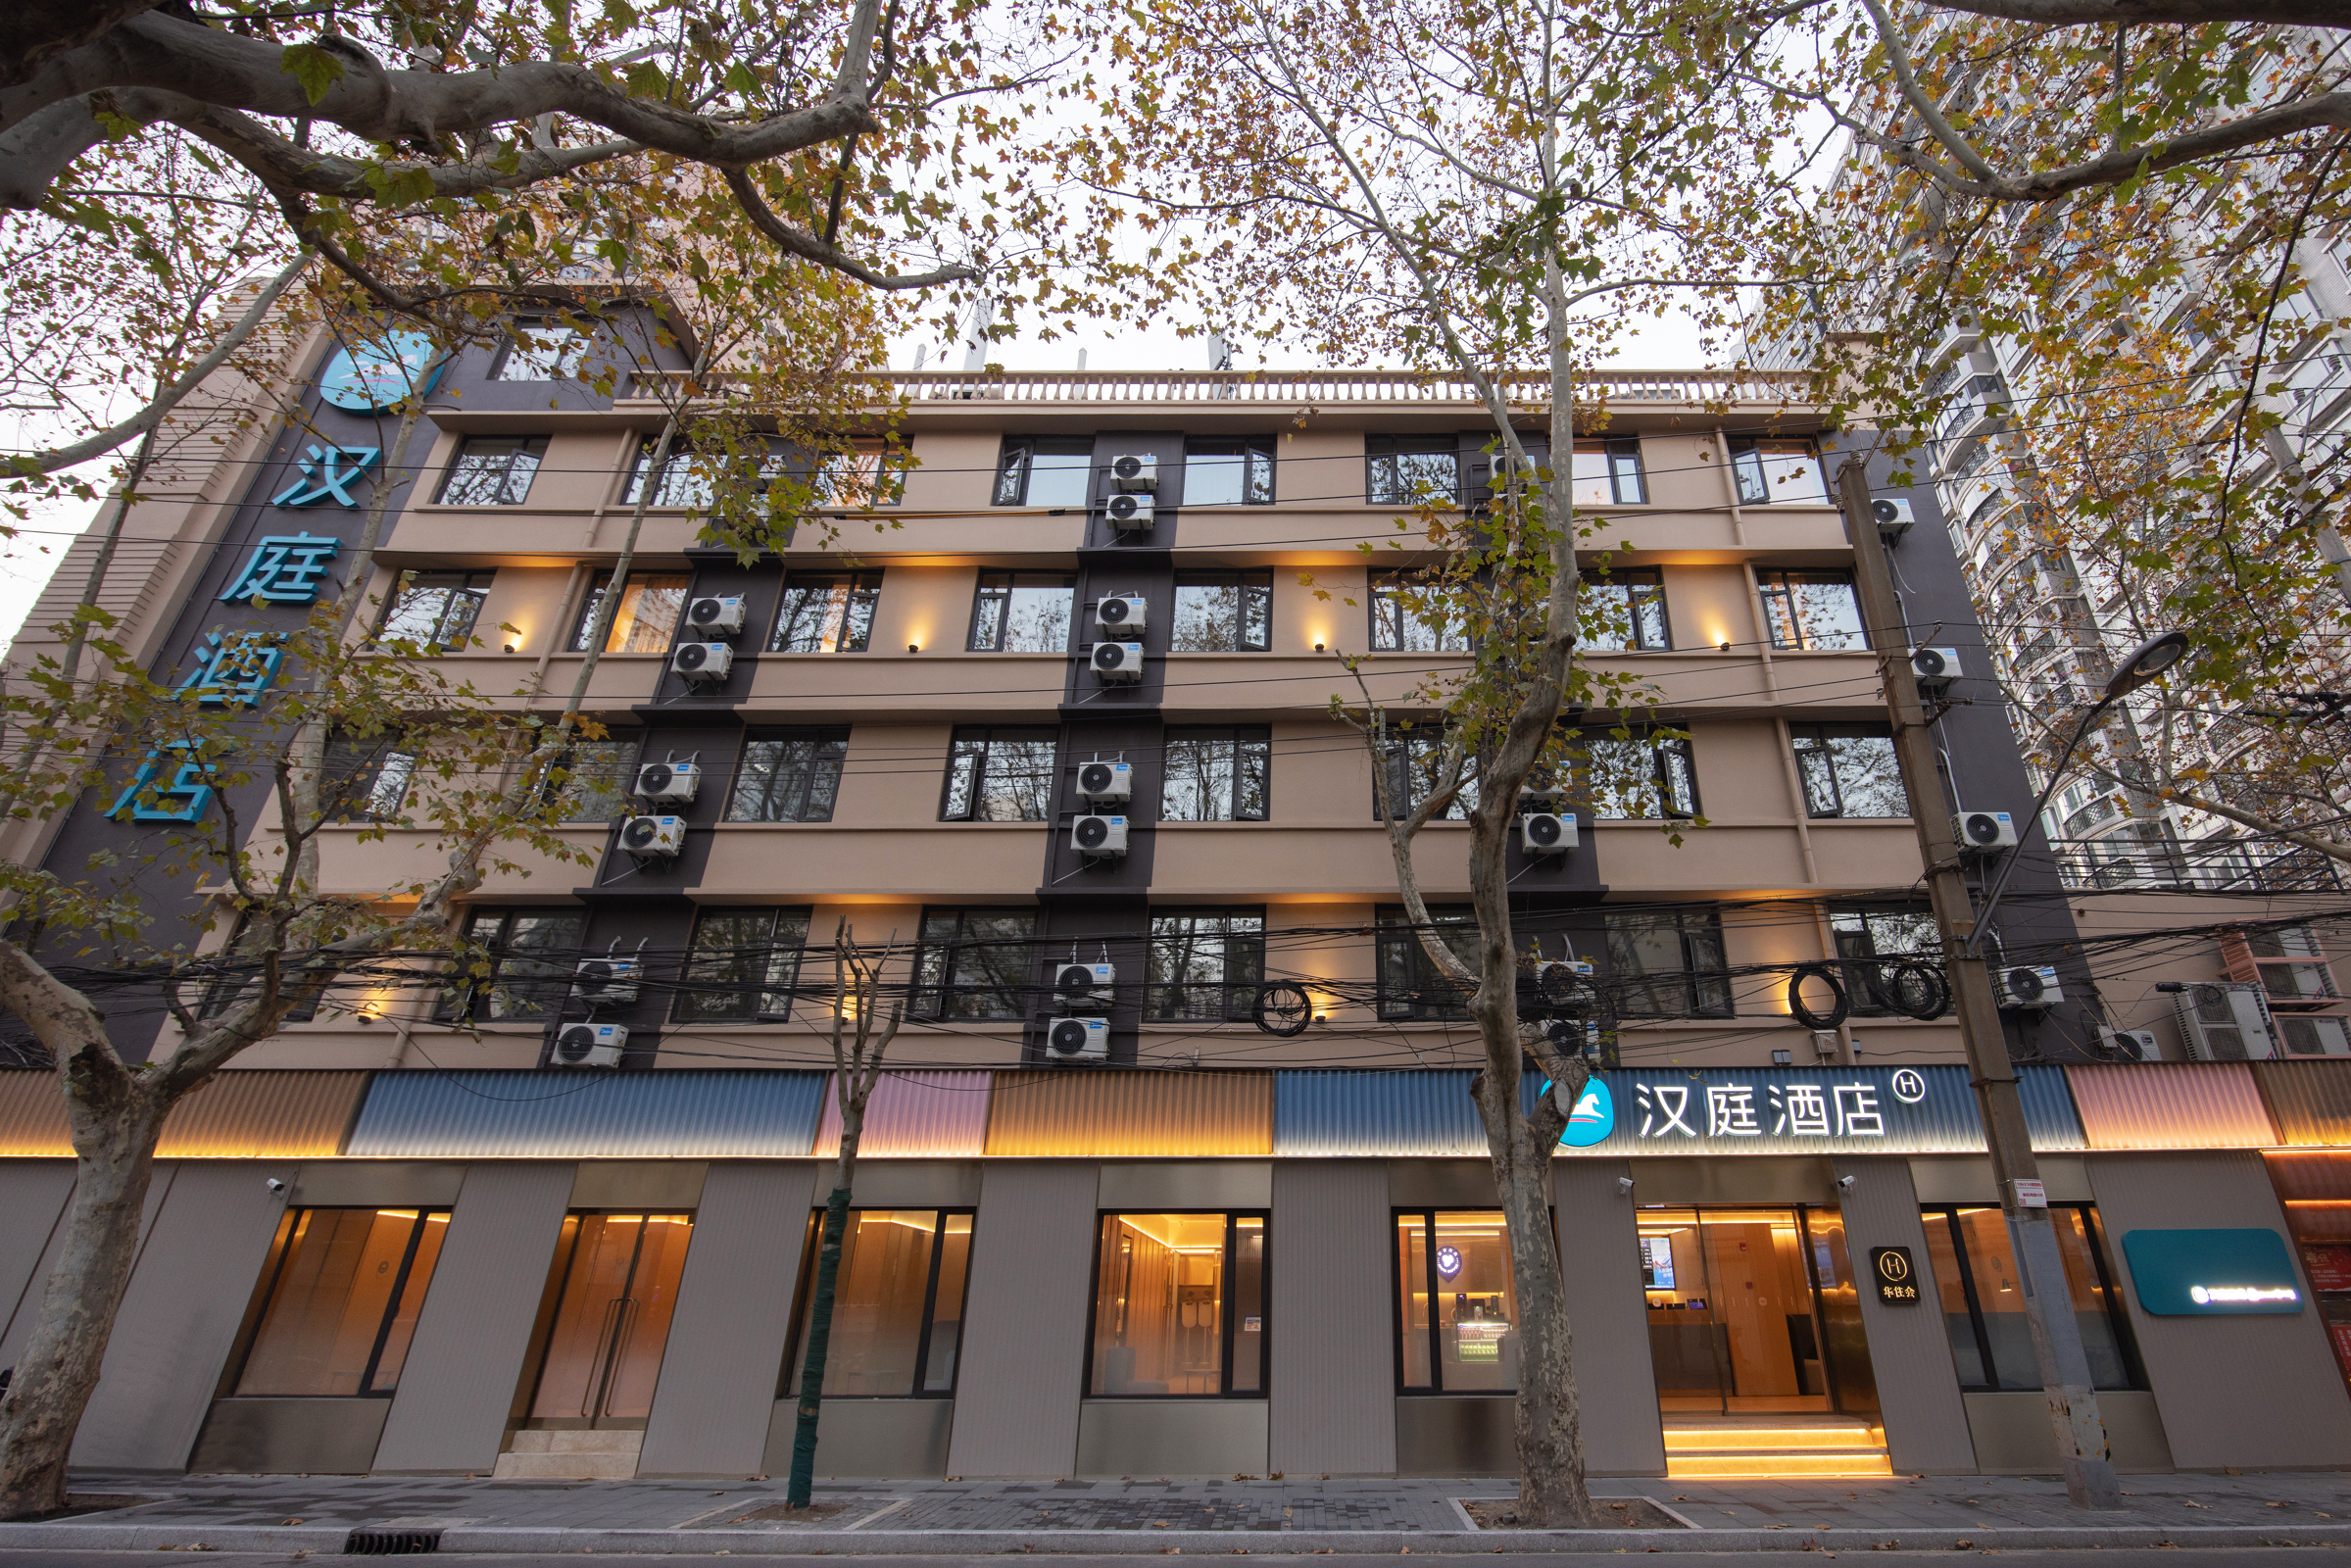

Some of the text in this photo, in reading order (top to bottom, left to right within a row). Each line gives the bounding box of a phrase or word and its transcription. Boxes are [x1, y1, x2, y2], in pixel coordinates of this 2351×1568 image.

[103, 443, 382, 823] 汉庭酒店
[1636, 1082, 1886, 1138] 汉庭酒店
[1883, 1285, 1916, 1298] 华住会
